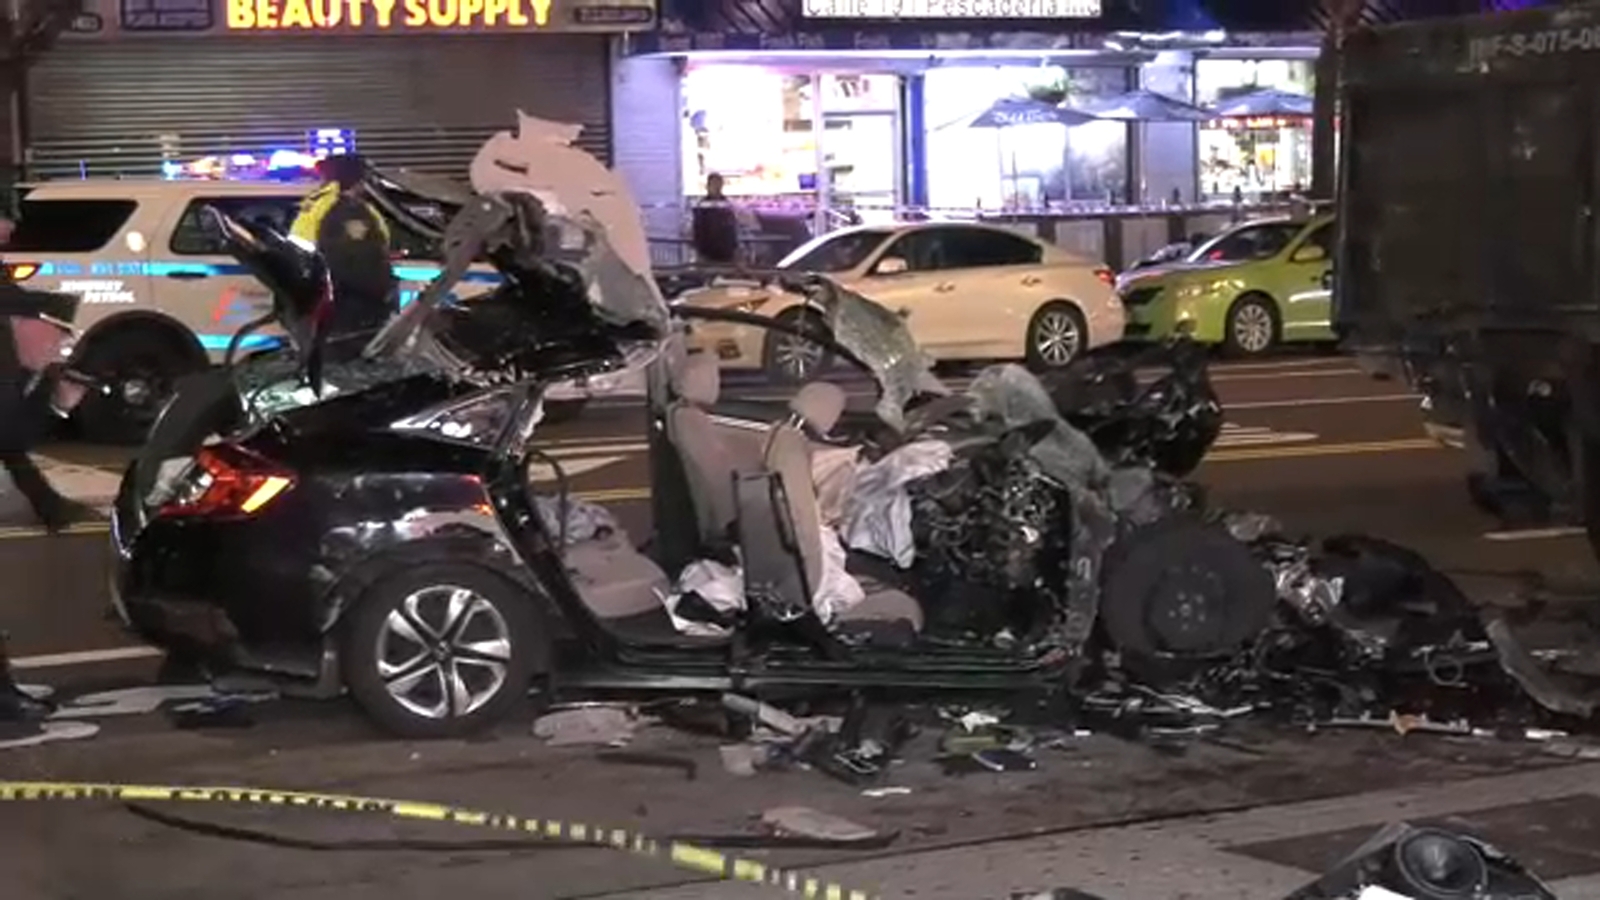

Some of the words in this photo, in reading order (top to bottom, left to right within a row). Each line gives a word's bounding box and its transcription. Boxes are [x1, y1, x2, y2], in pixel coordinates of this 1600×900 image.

[226, 0, 393, 29] BEAUTY
[404, 0, 552, 28] SUPPLY
[806, 0, 868, 16] Calle
